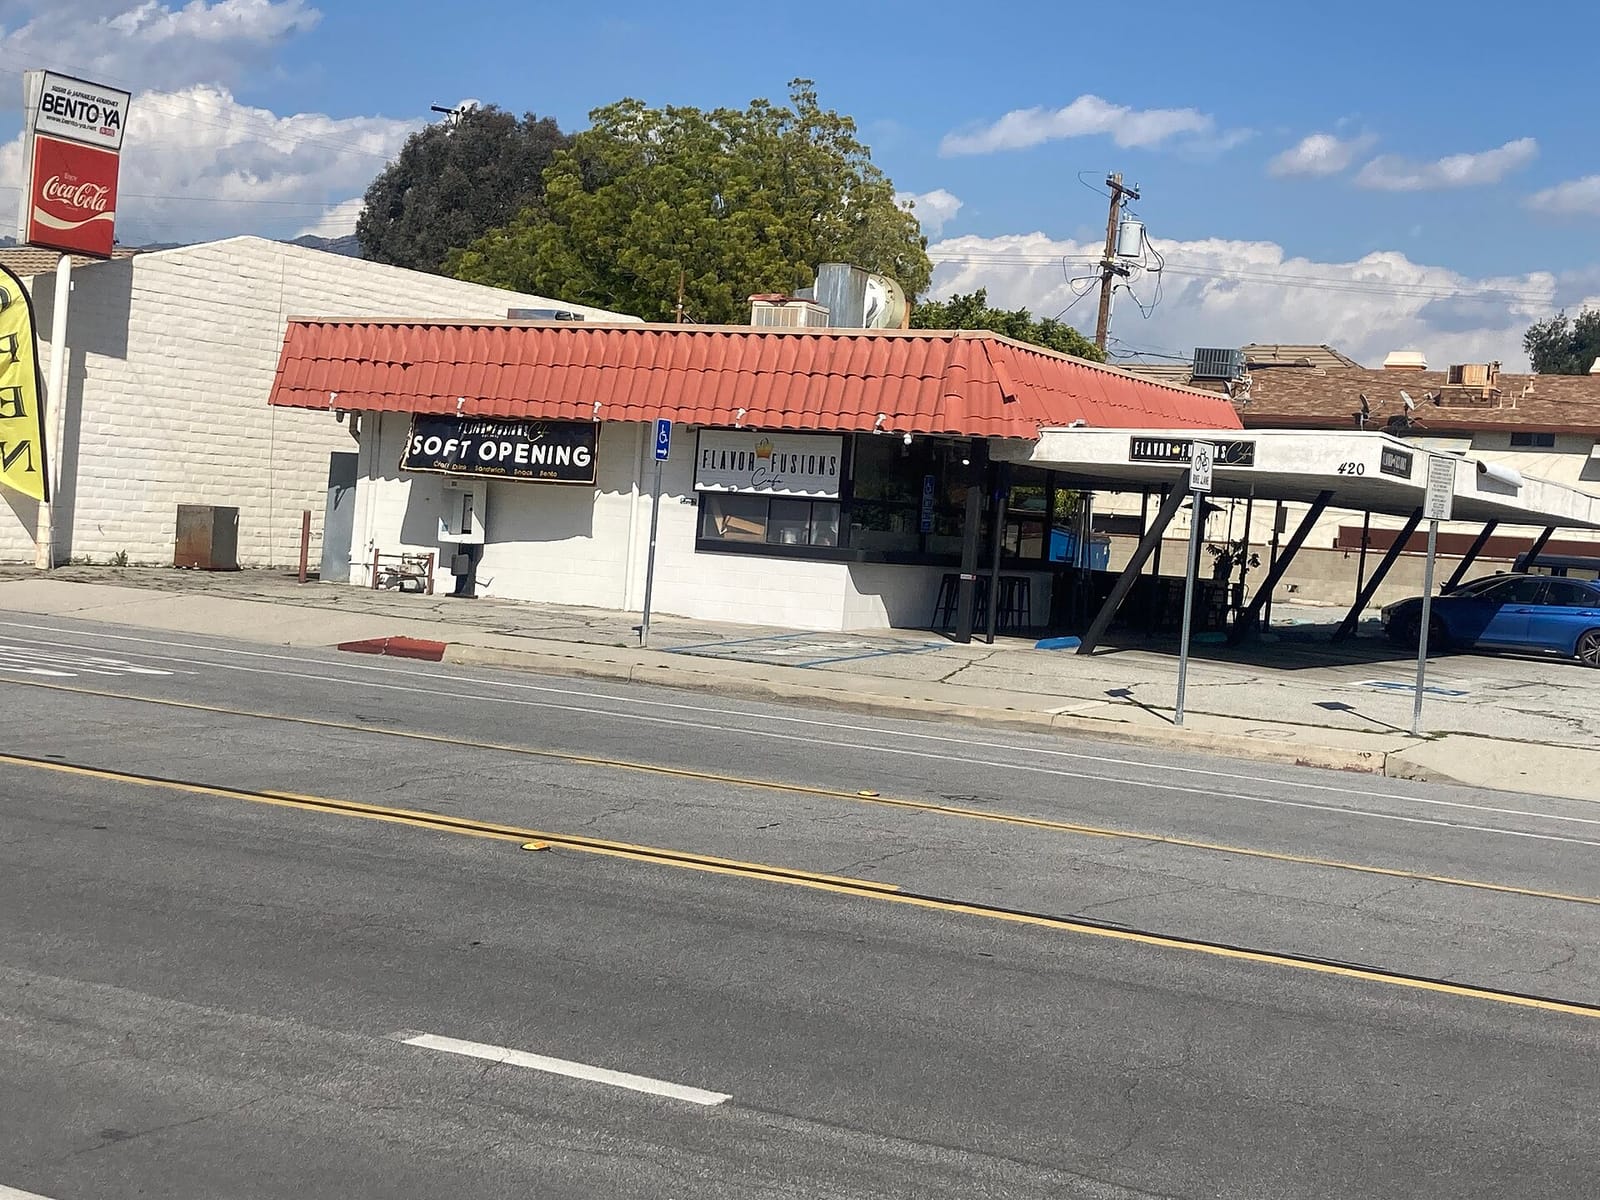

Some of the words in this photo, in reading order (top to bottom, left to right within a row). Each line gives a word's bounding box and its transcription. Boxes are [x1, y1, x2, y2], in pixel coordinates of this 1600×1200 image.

[42, 175, 109, 212] Coca-Cola
[412, 435, 471, 458] SOFT
[478, 441, 591, 467] OPENING
[1134, 441, 1172, 457] FLAVOR
[475, 465, 506, 473] Sandwich
[702, 449, 754, 471] FLAVOR
[771, 453, 836, 475] FUSIONS
[1337, 462, 1365, 475] 420
